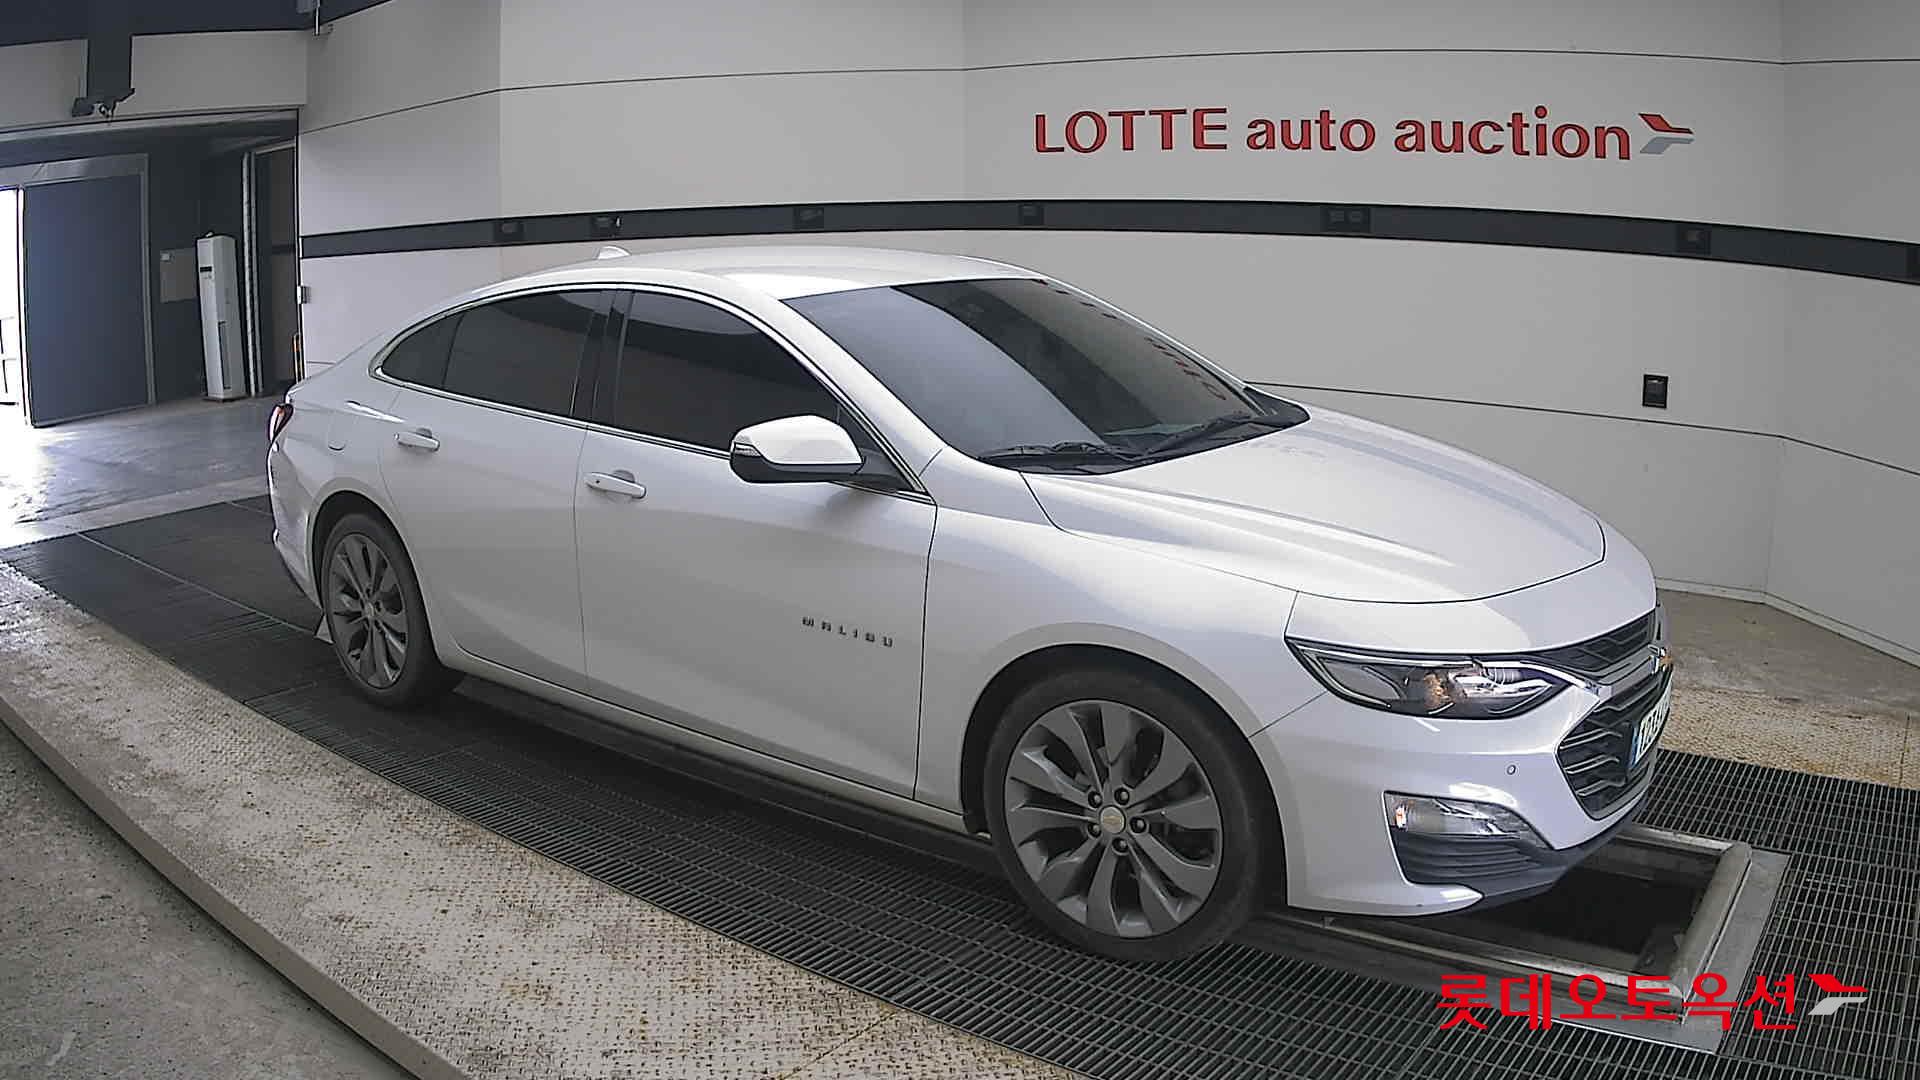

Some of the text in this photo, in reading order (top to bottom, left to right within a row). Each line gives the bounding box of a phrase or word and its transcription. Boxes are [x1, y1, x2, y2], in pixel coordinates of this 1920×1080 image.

[1034, 105, 1631, 160] LOTTE auto auction
[802, 617, 893, 648] MALIBU
